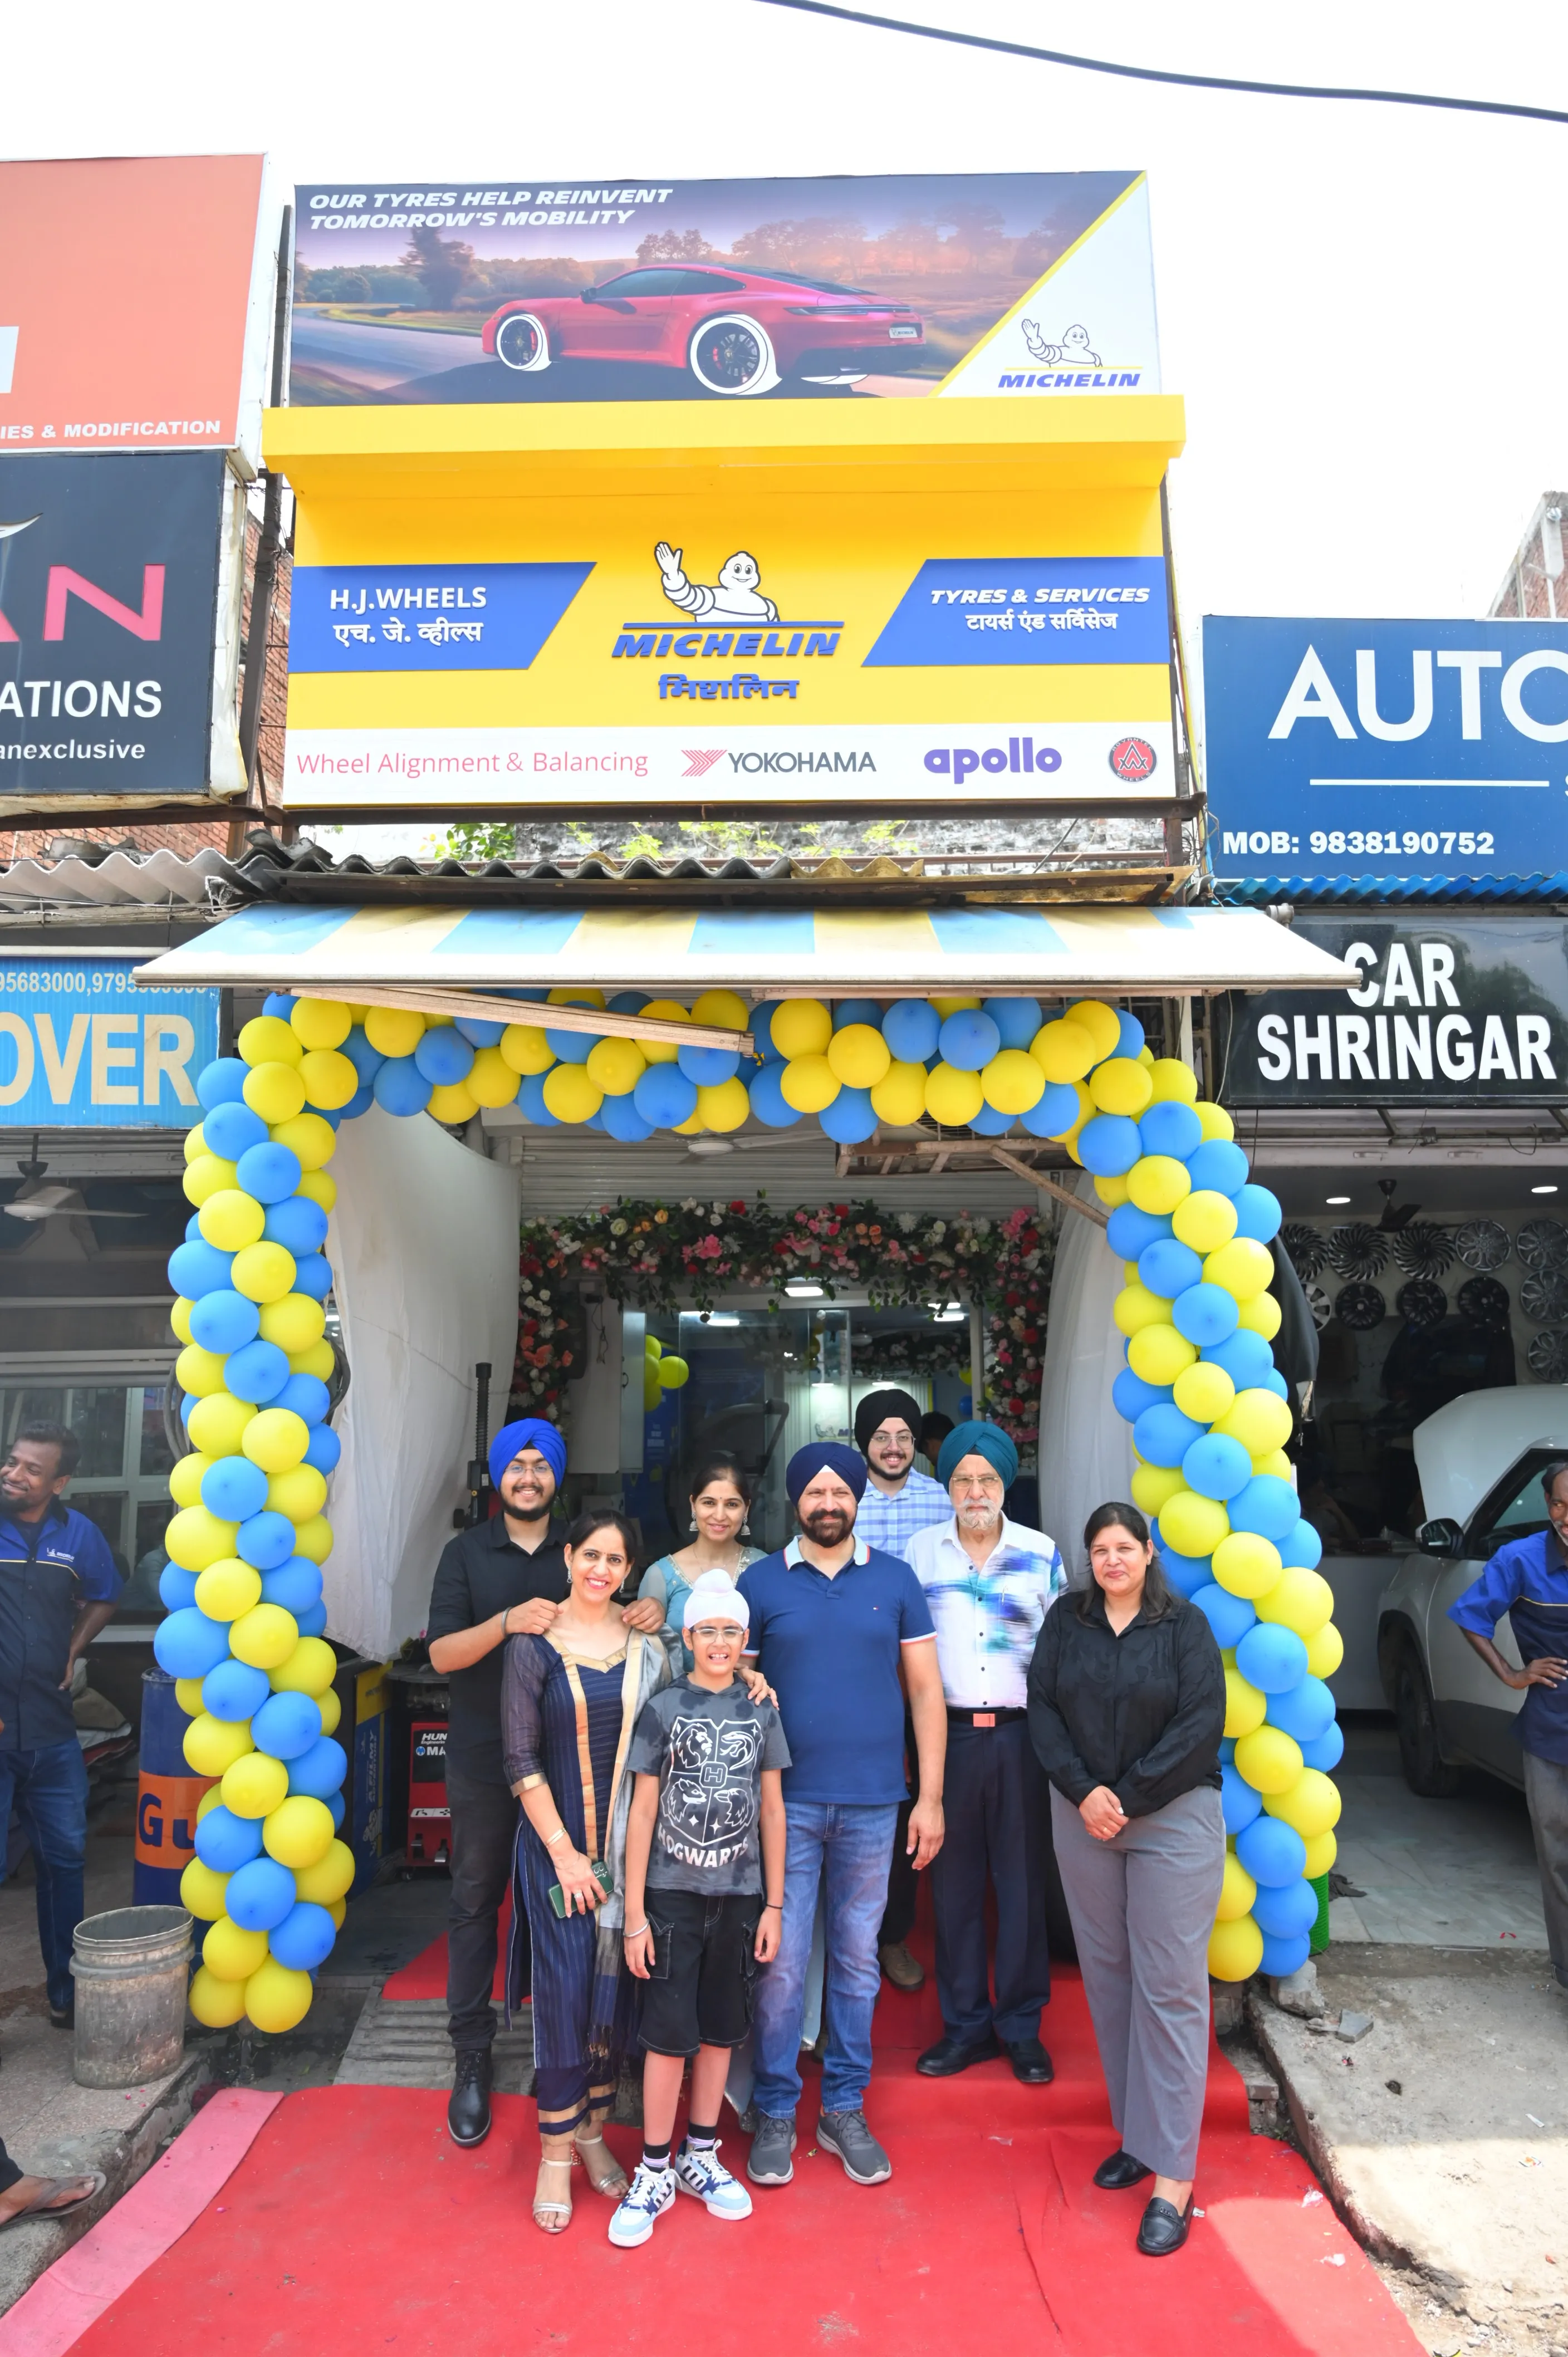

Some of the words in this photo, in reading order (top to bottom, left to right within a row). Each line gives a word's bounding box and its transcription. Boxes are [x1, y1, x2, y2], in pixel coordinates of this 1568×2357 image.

[310, 194, 366, 209] OUR
[374, 192, 457, 208] TYRES
[461, 191, 532, 207] HELP
[535, 189, 673, 205] REINVENT
[310, 212, 496, 230] TOMORROW'S
[501, 209, 635, 226] MOBILITY
[998, 373, 1140, 388] MICHELIN
[0, 425, 35, 439] IES
[41, 424, 56, 438] &
[64, 420, 221, 438] MODIFICATION
[0, 563, 166, 643] N
[330, 587, 487, 615] H.J.WHEELS
[931, 589, 1007, 605] TYRES
[1011, 589, 1028, 604] &
[1034, 588, 1150, 603] SERVICES
[332, 624, 376, 648] एच.
[381, 616, 411, 644] जे.
[416, 616, 484, 646] व्हील्स
[965, 608, 1015, 631] टायर्स
[1018, 610, 1046, 633] एंड
[1049, 607, 1119, 630] सर्विसेज
[611, 633, 841, 658] MICHELIN
[0, 680, 162, 718] ATIONS
[1267, 644, 1568, 743] AUTO
[297, 753, 370, 775] Wheel
[378, 751, 501, 778] Alignment
[506, 752, 525, 772] &
[533, 751, 649, 777] Balancing
[727, 751, 877, 773] YOKOHAMA
[924, 737, 1062, 785] apollo
[1117, 772, 1152, 782] WHEELS
[1222, 831, 1300, 855] MOB:
[1309, 830, 1495, 855] 9838190752
[1344, 942, 1461, 1007] CAR
[0, 1012, 200, 1106] OVER
[1257, 1013, 1557, 1082] SHRINGAR
[704, 1767, 723, 1783] H
[658, 1822, 749, 1868] HOGWARTS
